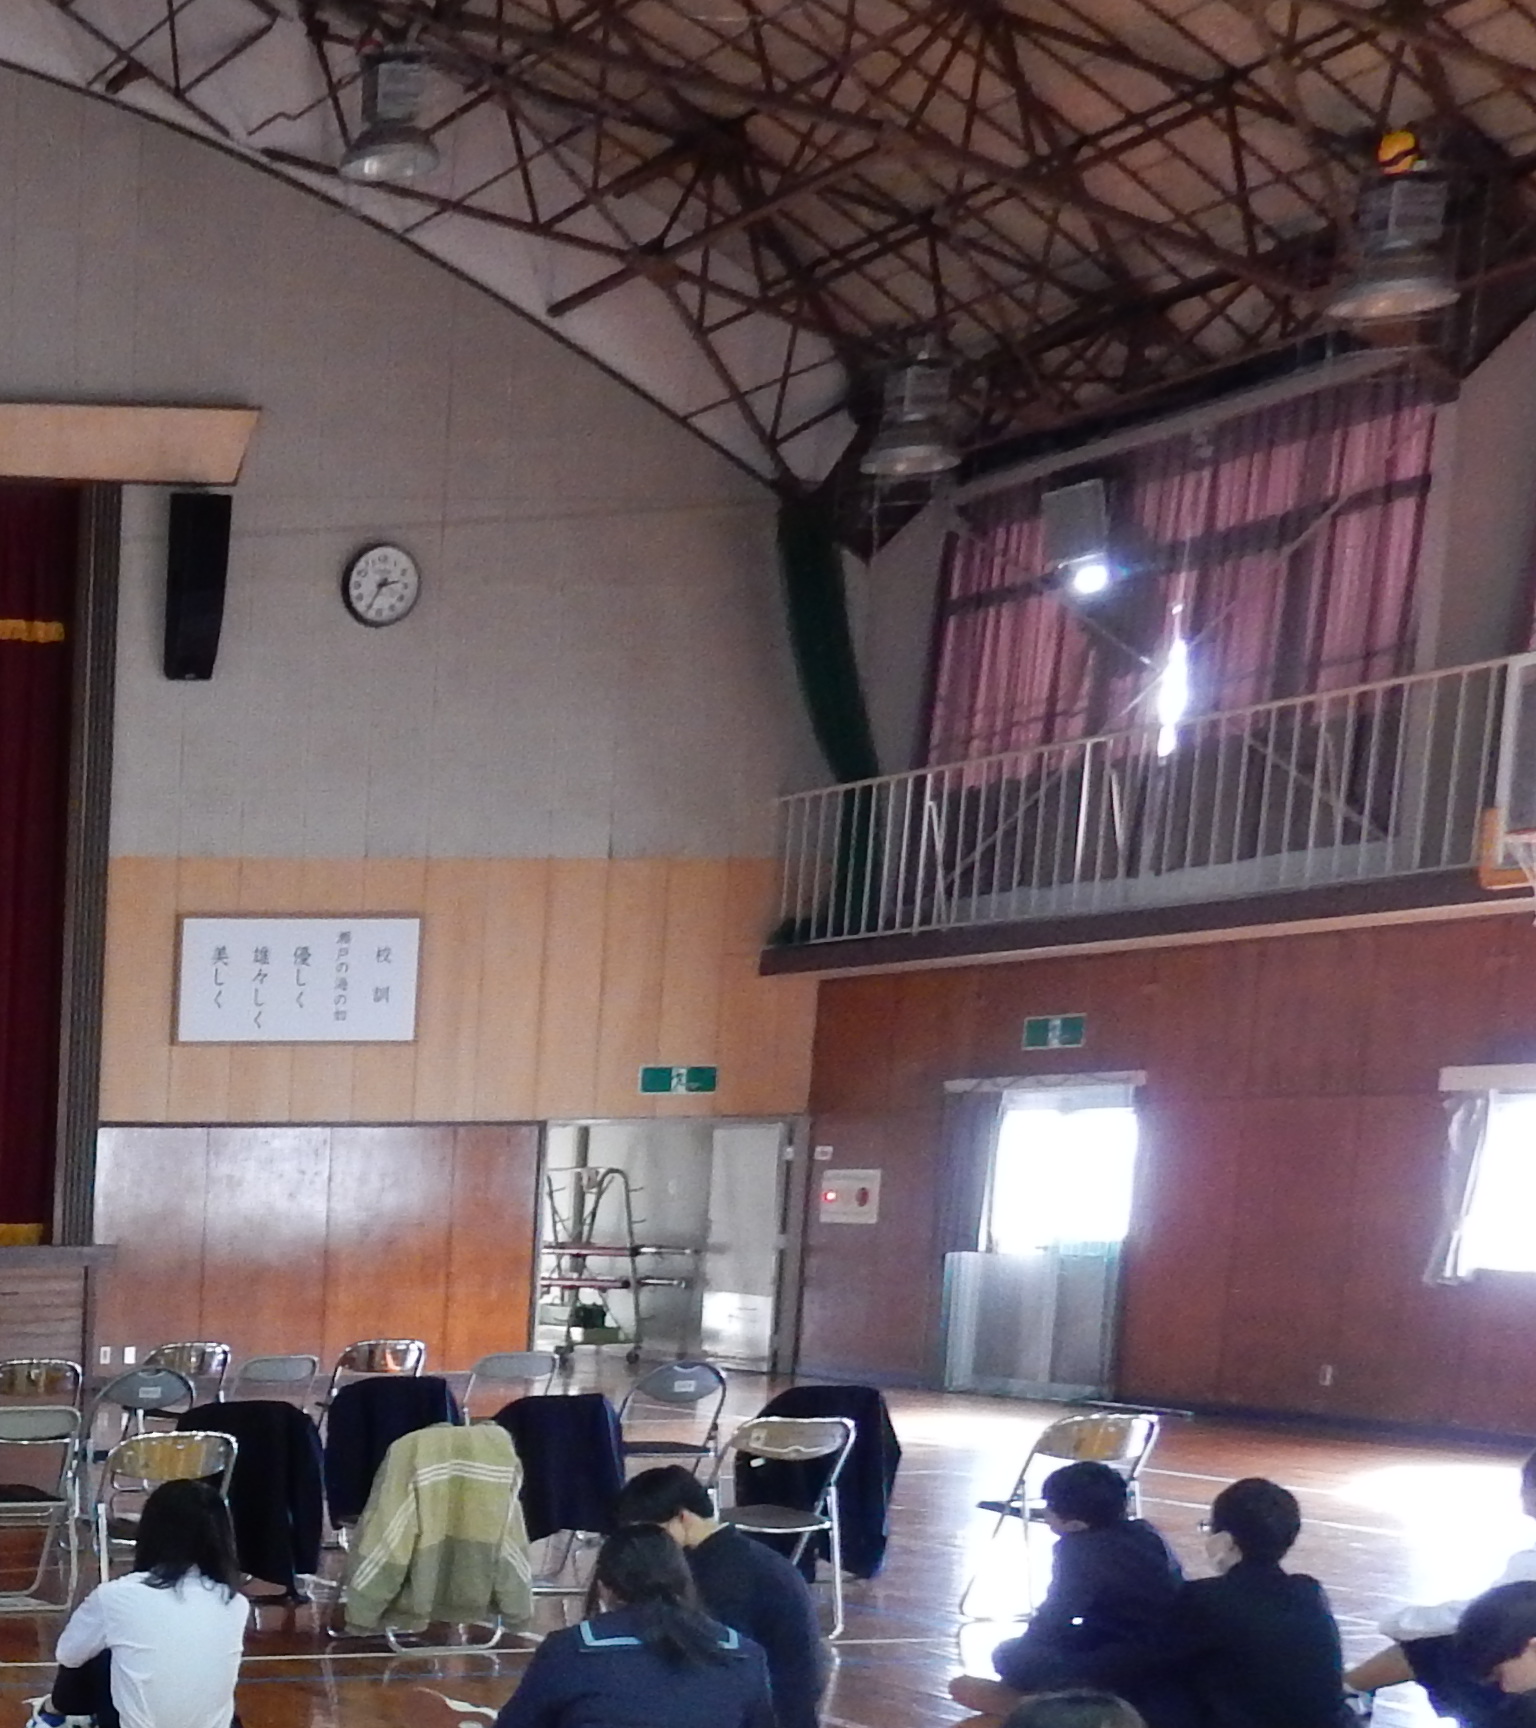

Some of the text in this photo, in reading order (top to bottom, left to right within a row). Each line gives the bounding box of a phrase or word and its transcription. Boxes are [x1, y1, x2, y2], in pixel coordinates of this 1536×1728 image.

[211, 944, 229, 1010] 美しく
[252, 945, 271, 1029] 雄々しく
[293, 945, 312, 1009] 優しく
